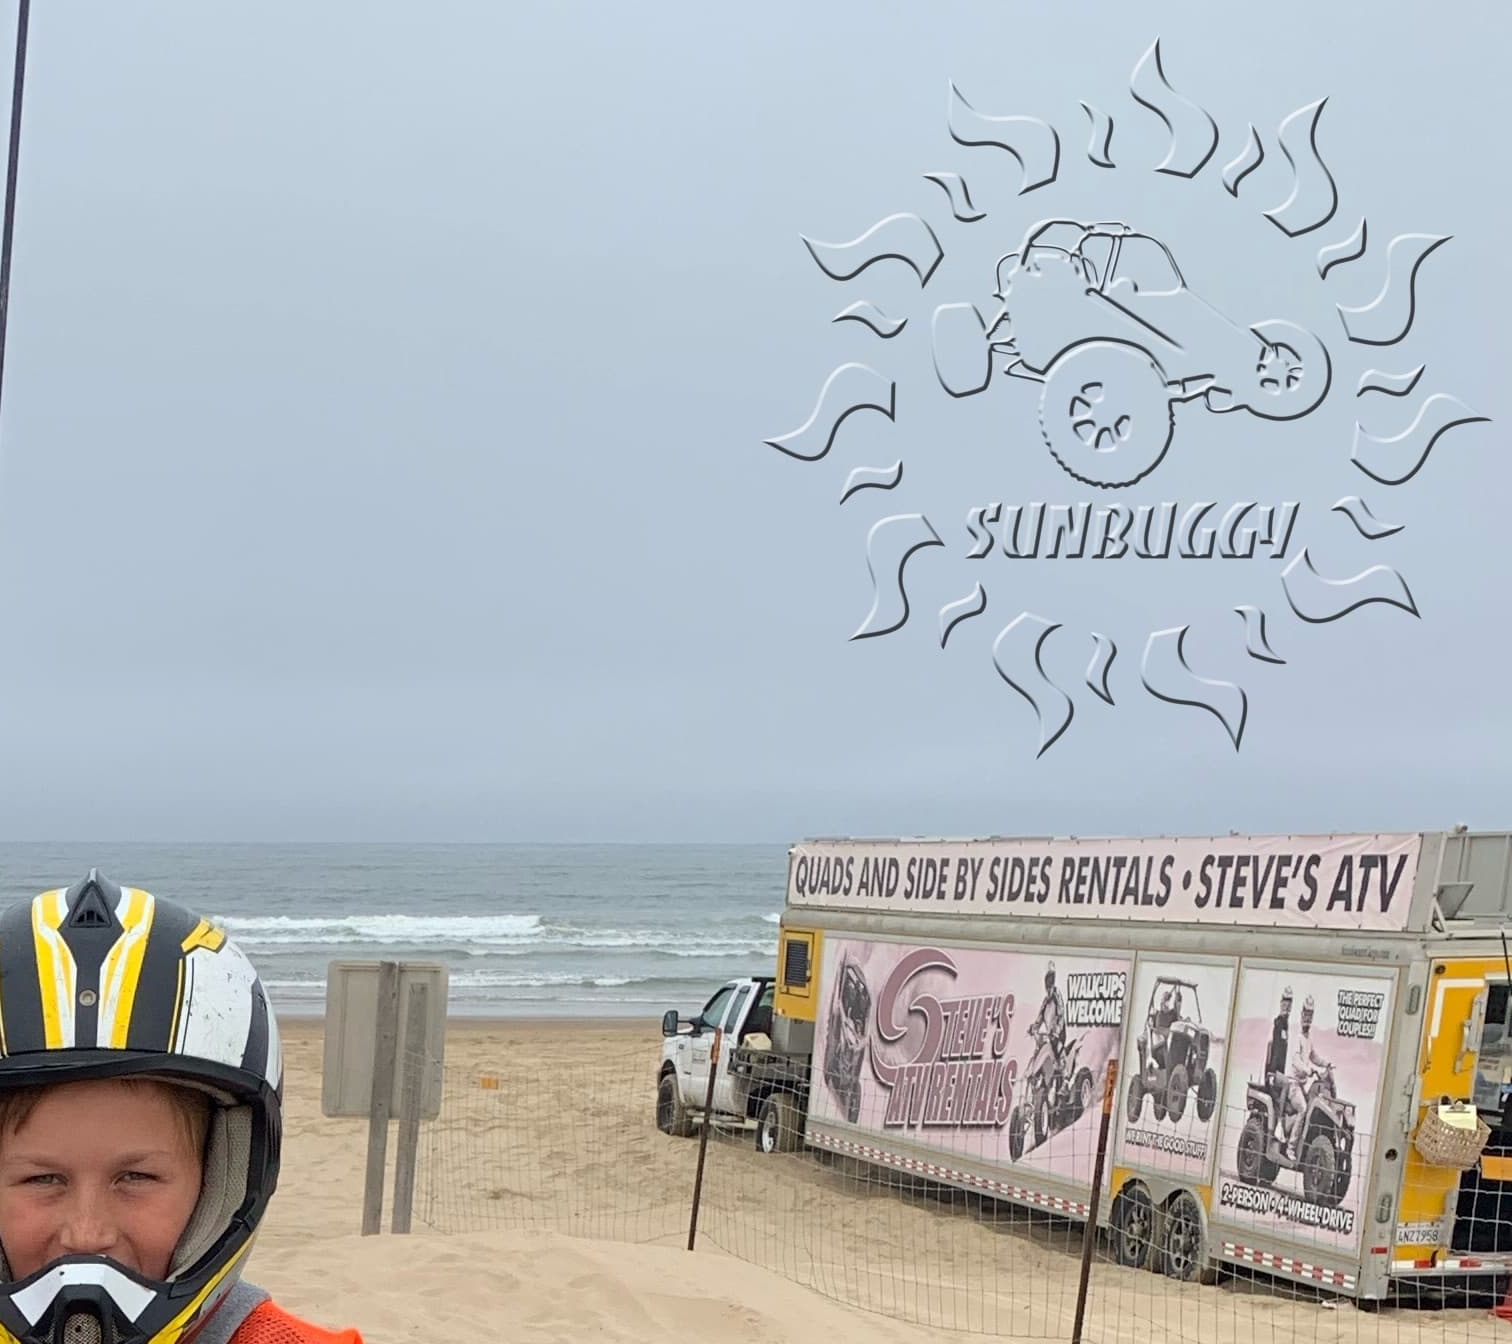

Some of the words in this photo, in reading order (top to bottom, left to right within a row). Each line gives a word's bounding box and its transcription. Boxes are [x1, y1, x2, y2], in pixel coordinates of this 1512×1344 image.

[795, 856, 854, 898] QUADS
[856, 857, 899, 898] AND
[903, 857, 950, 900] SIDE
[953, 857, 984, 901] BY
[985, 856, 1052, 903] SIDES
[1058, 855, 1175, 907] RENTALS
[1195, 853, 1321, 912] STEVE'S
[1326, 854, 1408, 913] ATV
[1067, 971, 1127, 1000] WALK-UPS
[1338, 990, 1354, 1005] THE
[1353, 991, 1384, 1009] PERFECT
[870, 947, 1015, 1086] STEVE'S
[1067, 1000, 1123, 1026] WELCOME
[1339, 1005, 1362, 1022] QUAD
[1362, 1007, 1379, 1023] FOR
[885, 1064, 934, 1128] ATV
[922, 1059, 1018, 1128] RENTALS
[1220, 1182, 1270, 1213] 2-PERSON
[1275, 1193, 1322, 1225] 4-WHEEL
[1321, 1205, 1355, 1235] DRIVE
